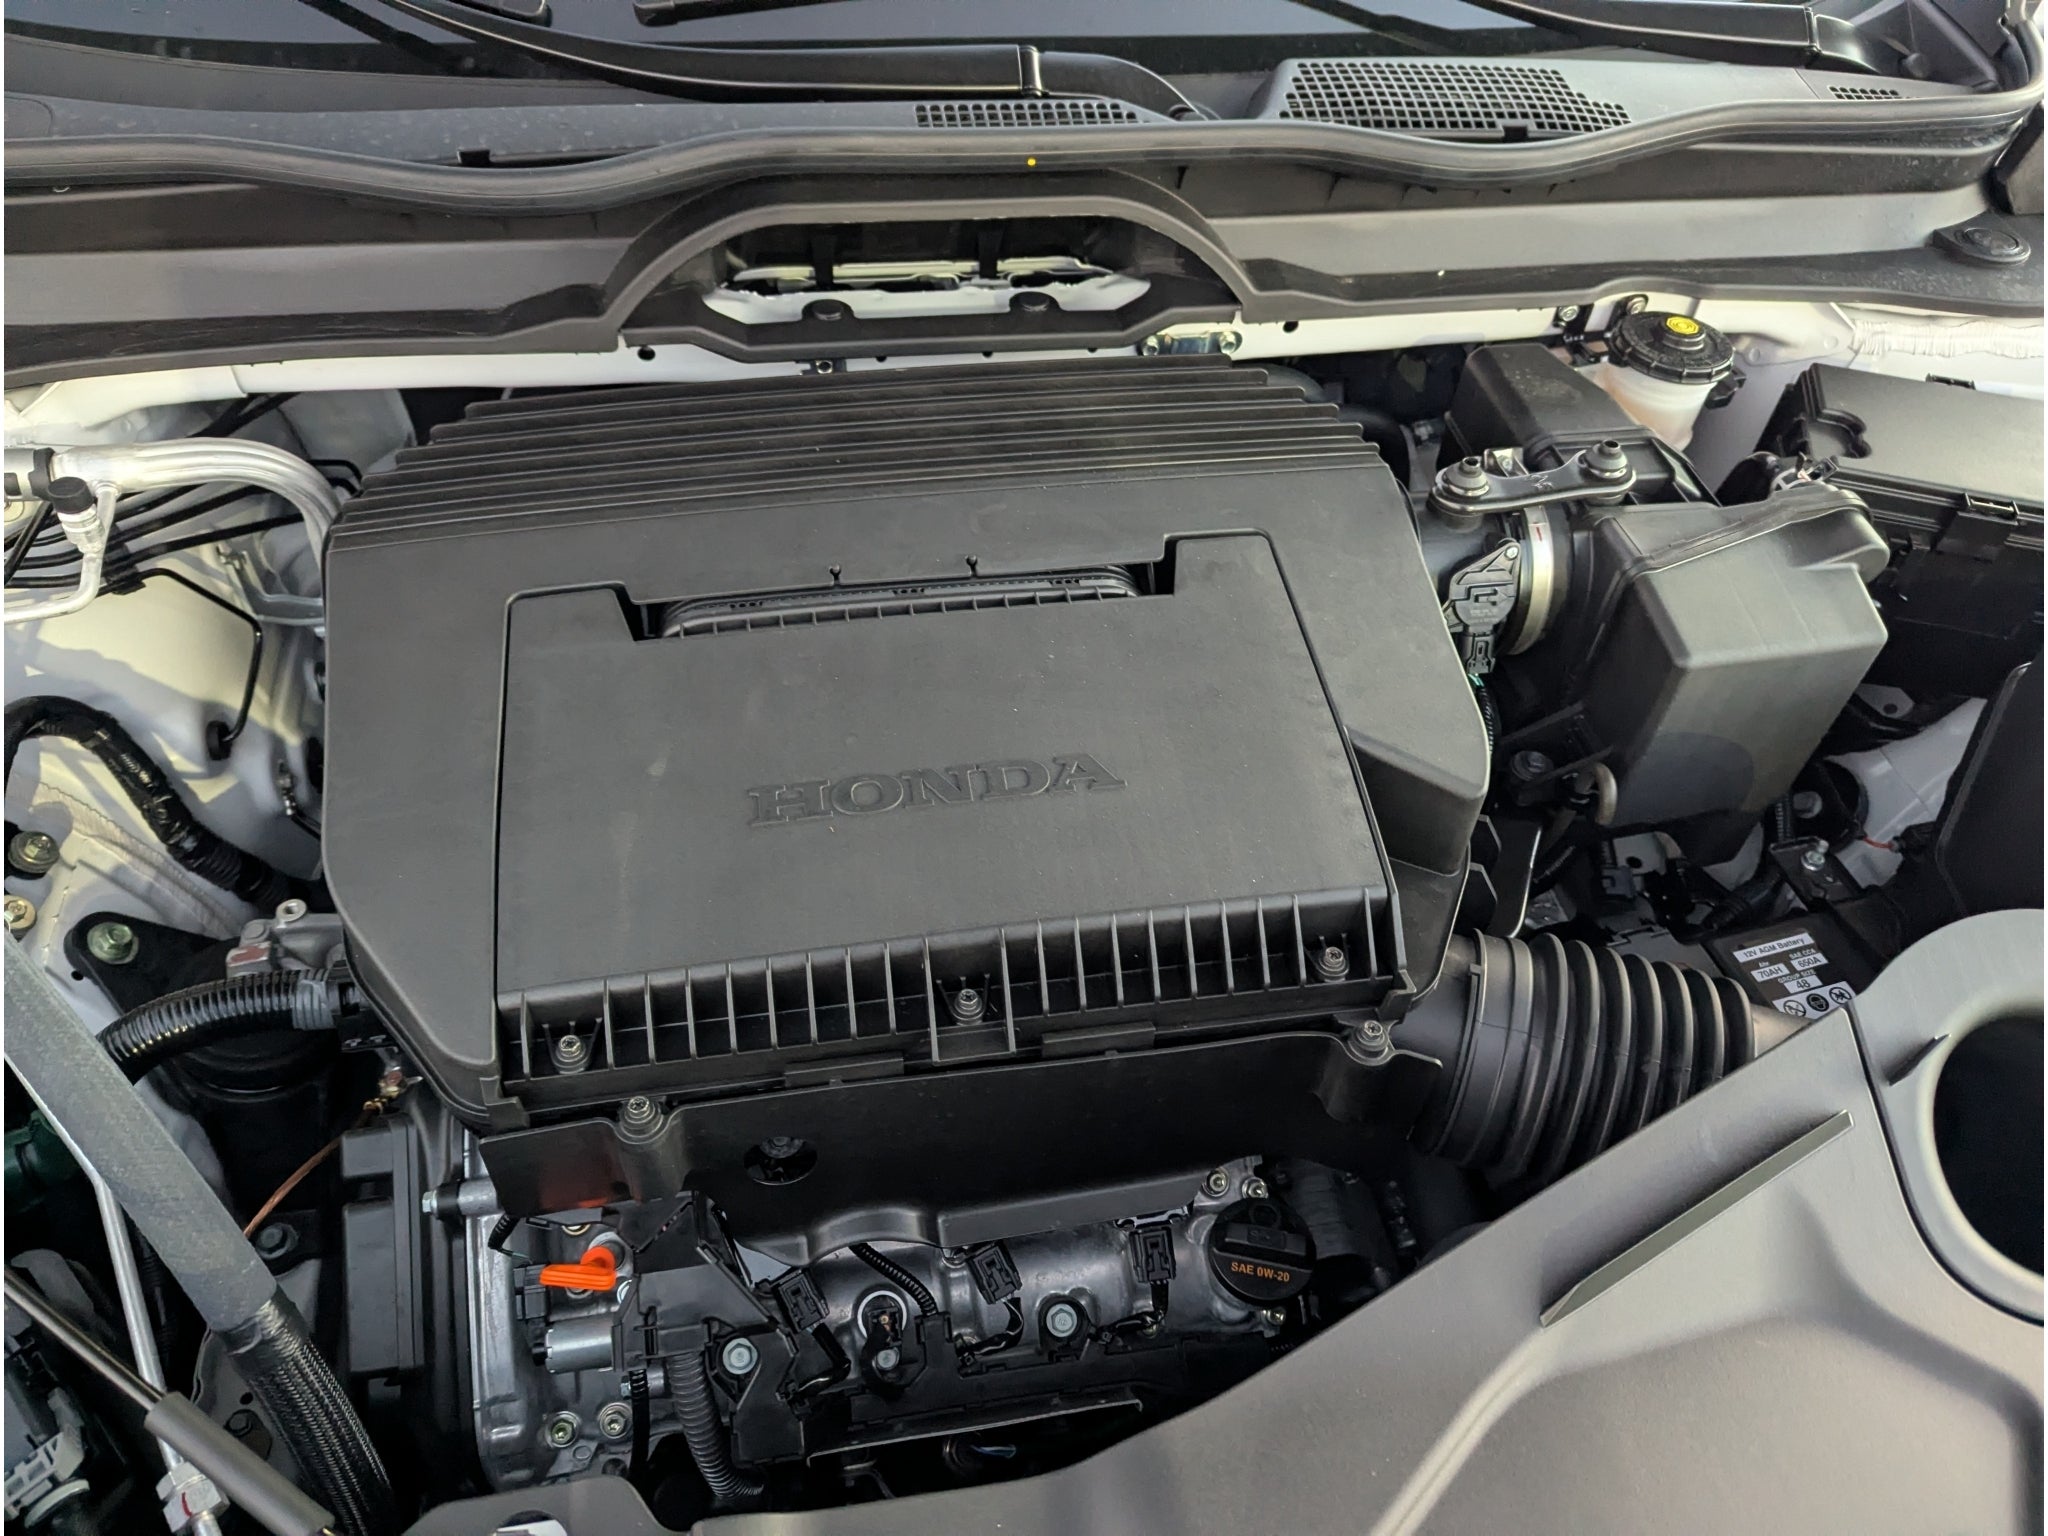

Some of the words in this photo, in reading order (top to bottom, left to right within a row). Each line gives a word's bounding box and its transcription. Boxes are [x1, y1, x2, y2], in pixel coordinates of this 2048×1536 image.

[747, 752, 1128, 827] HONDA
[1743, 949, 1757, 958] 12V
[1759, 945, 1777, 953] AGM
[1778, 938, 1805, 949] Battery
[1797, 956, 1822, 968] 650A
[1757, 966, 1783, 979] 70AH
[1796, 979, 1810, 990] 48
[1231, 1261, 1254, 1275] SAE
[1256, 1266, 1290, 1282] 0W-20
